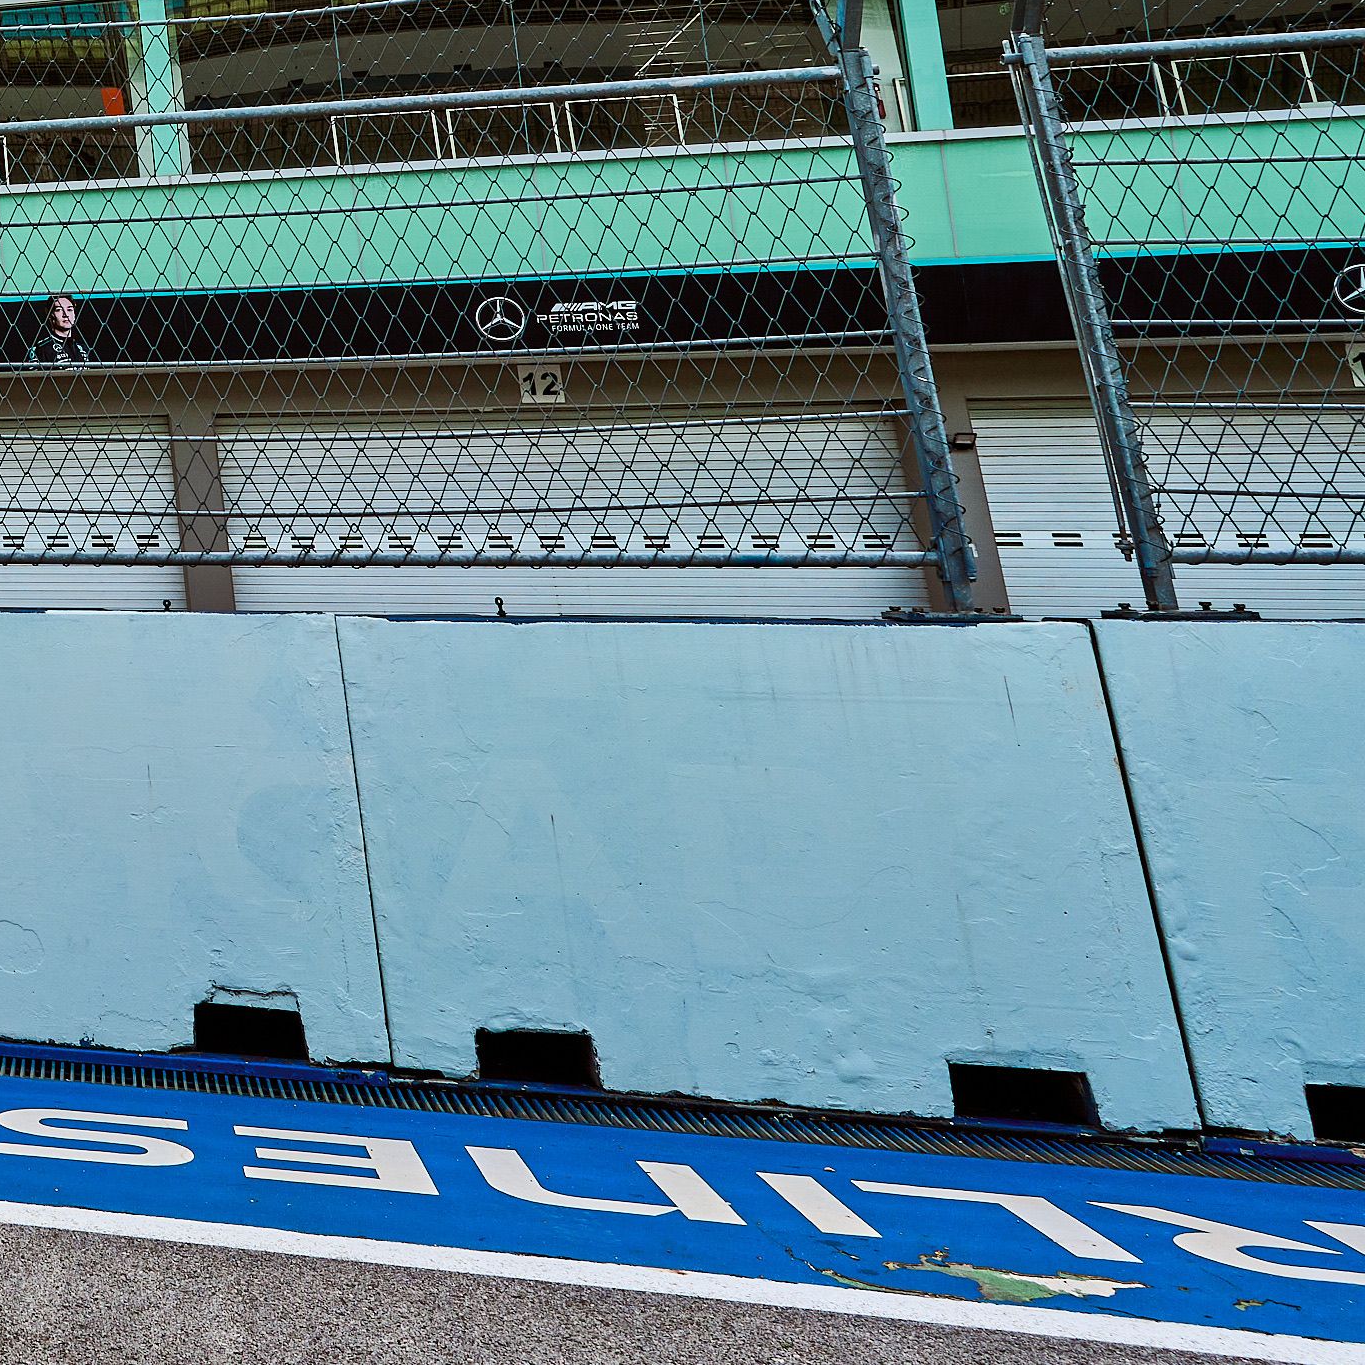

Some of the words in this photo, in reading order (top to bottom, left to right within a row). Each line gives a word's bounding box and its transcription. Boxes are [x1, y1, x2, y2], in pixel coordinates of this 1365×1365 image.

[537, 311, 638, 324] PETRONAS
[552, 324, 593, 332] FORMULA
[596, 323, 614, 331] ONE
[616, 322, 640, 330] TEAM
[522, 372, 561, 396] 12
